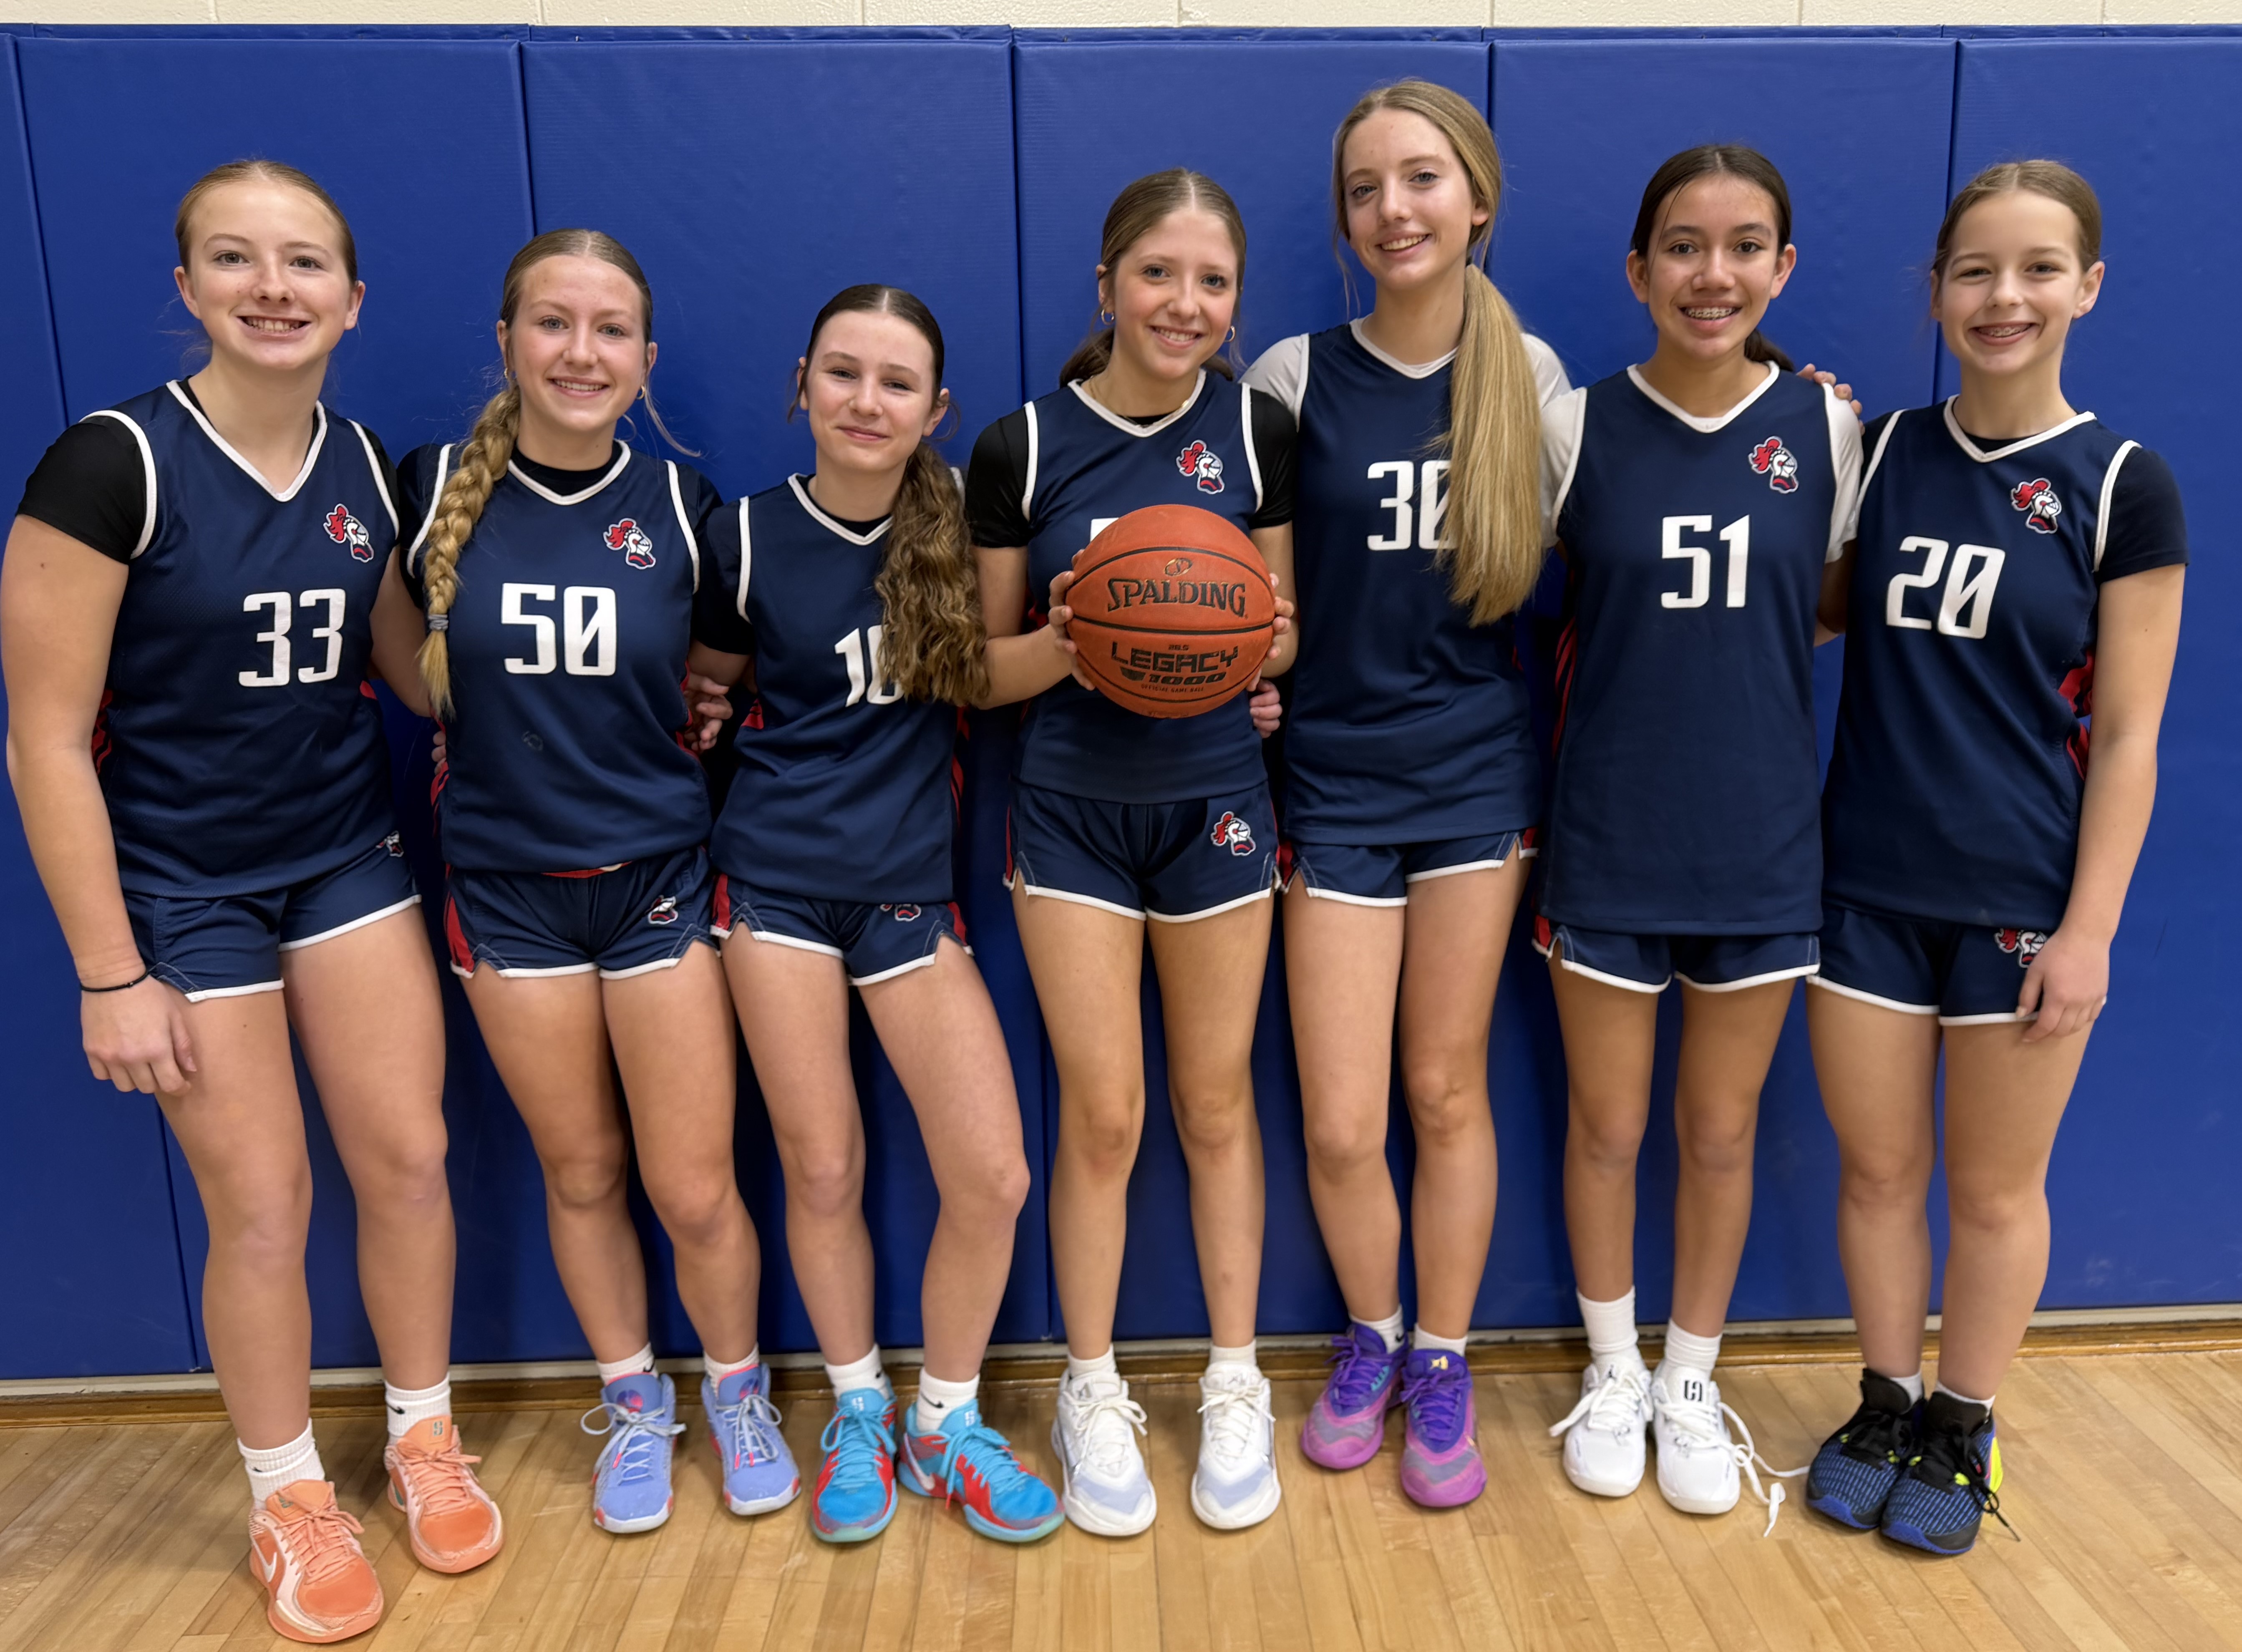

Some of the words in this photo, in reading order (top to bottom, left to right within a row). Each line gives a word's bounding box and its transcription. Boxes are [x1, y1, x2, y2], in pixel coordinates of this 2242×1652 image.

[1108, 579, 1246, 617] SPALDING
[1661, 515, 1749, 609] 51
[1886, 536, 2005, 639] 20
[239, 588, 345, 687] 33
[501, 583, 617, 676] 50
[1111, 642, 1238, 672] LEGACY
[1149, 672, 1226, 685] 1000
